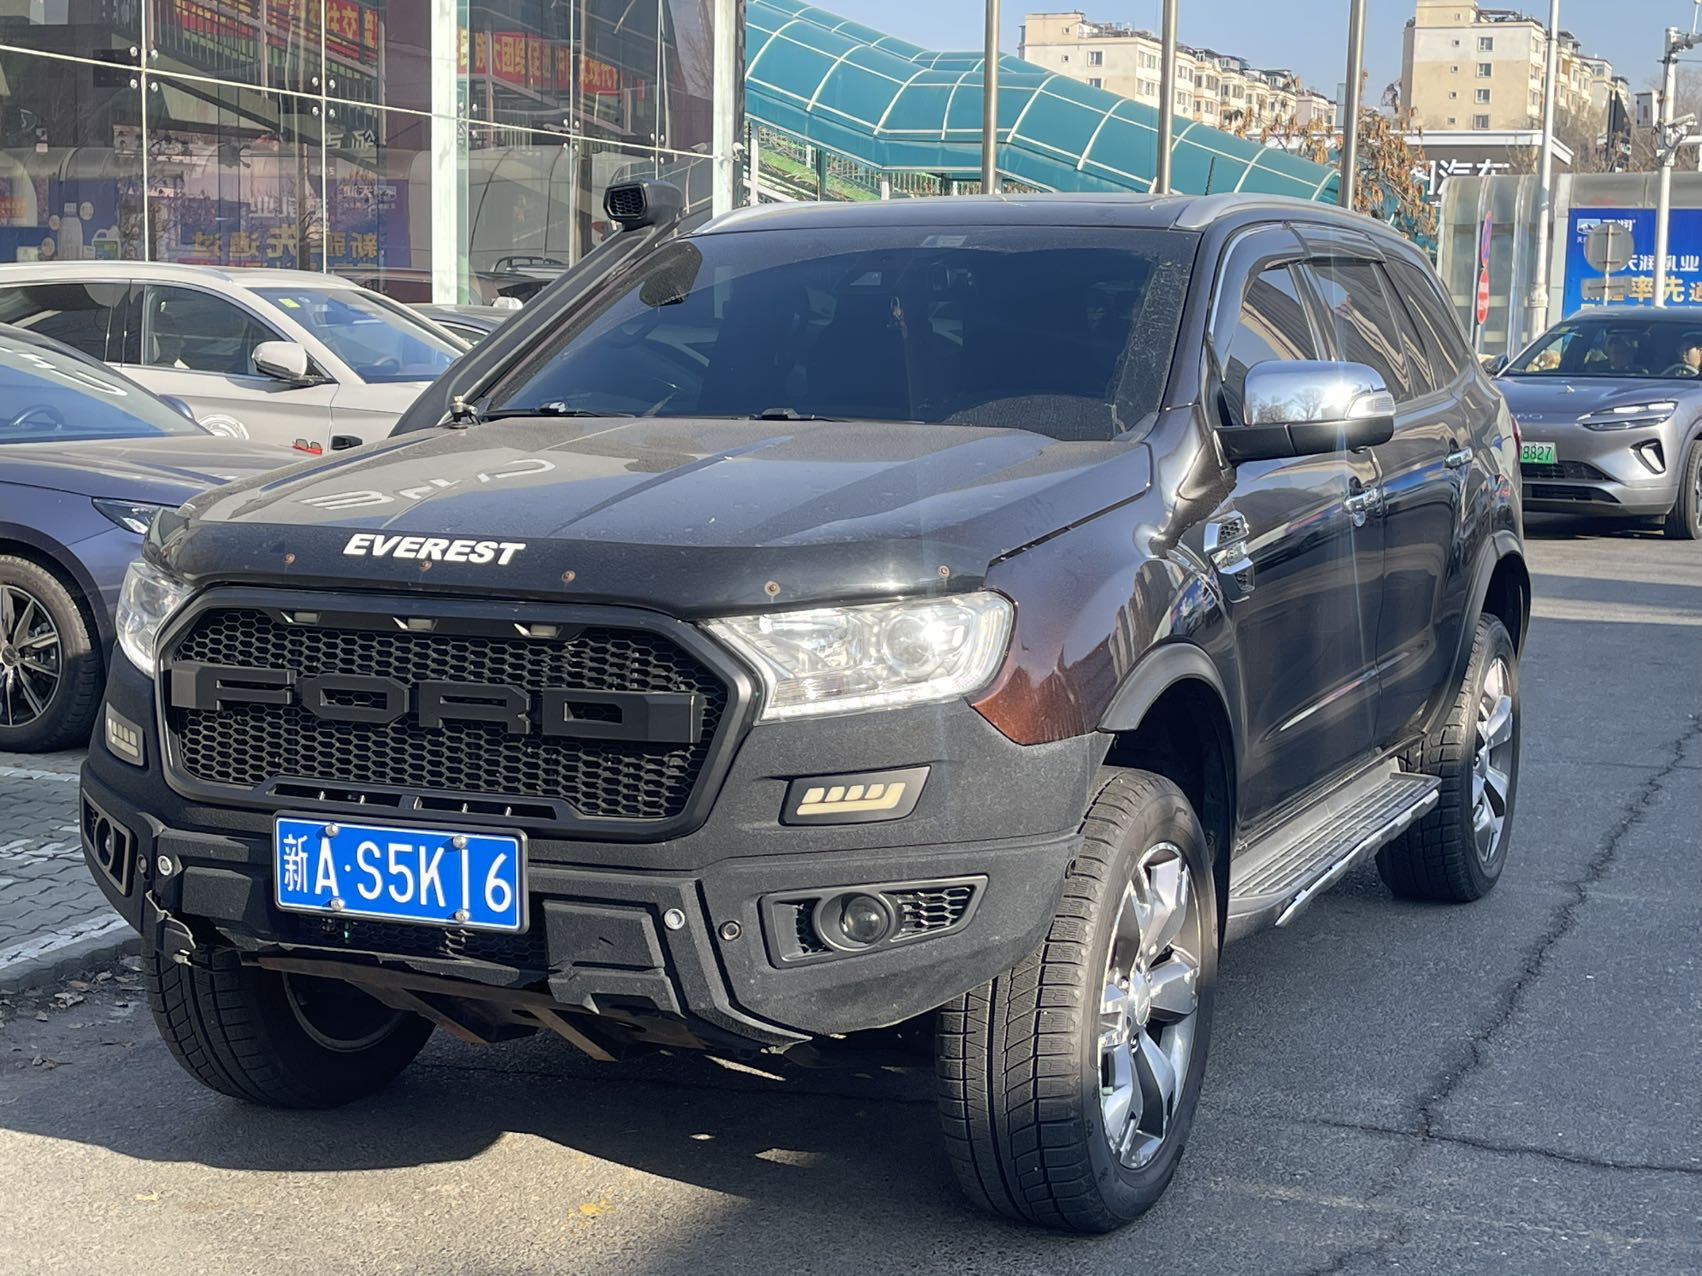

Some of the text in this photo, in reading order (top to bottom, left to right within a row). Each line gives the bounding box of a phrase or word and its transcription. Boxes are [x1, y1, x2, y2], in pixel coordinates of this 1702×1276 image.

[1520, 445, 1552, 461] 8827
[342, 532, 527, 566] EVEREST
[171, 660, 702, 744] FORD
